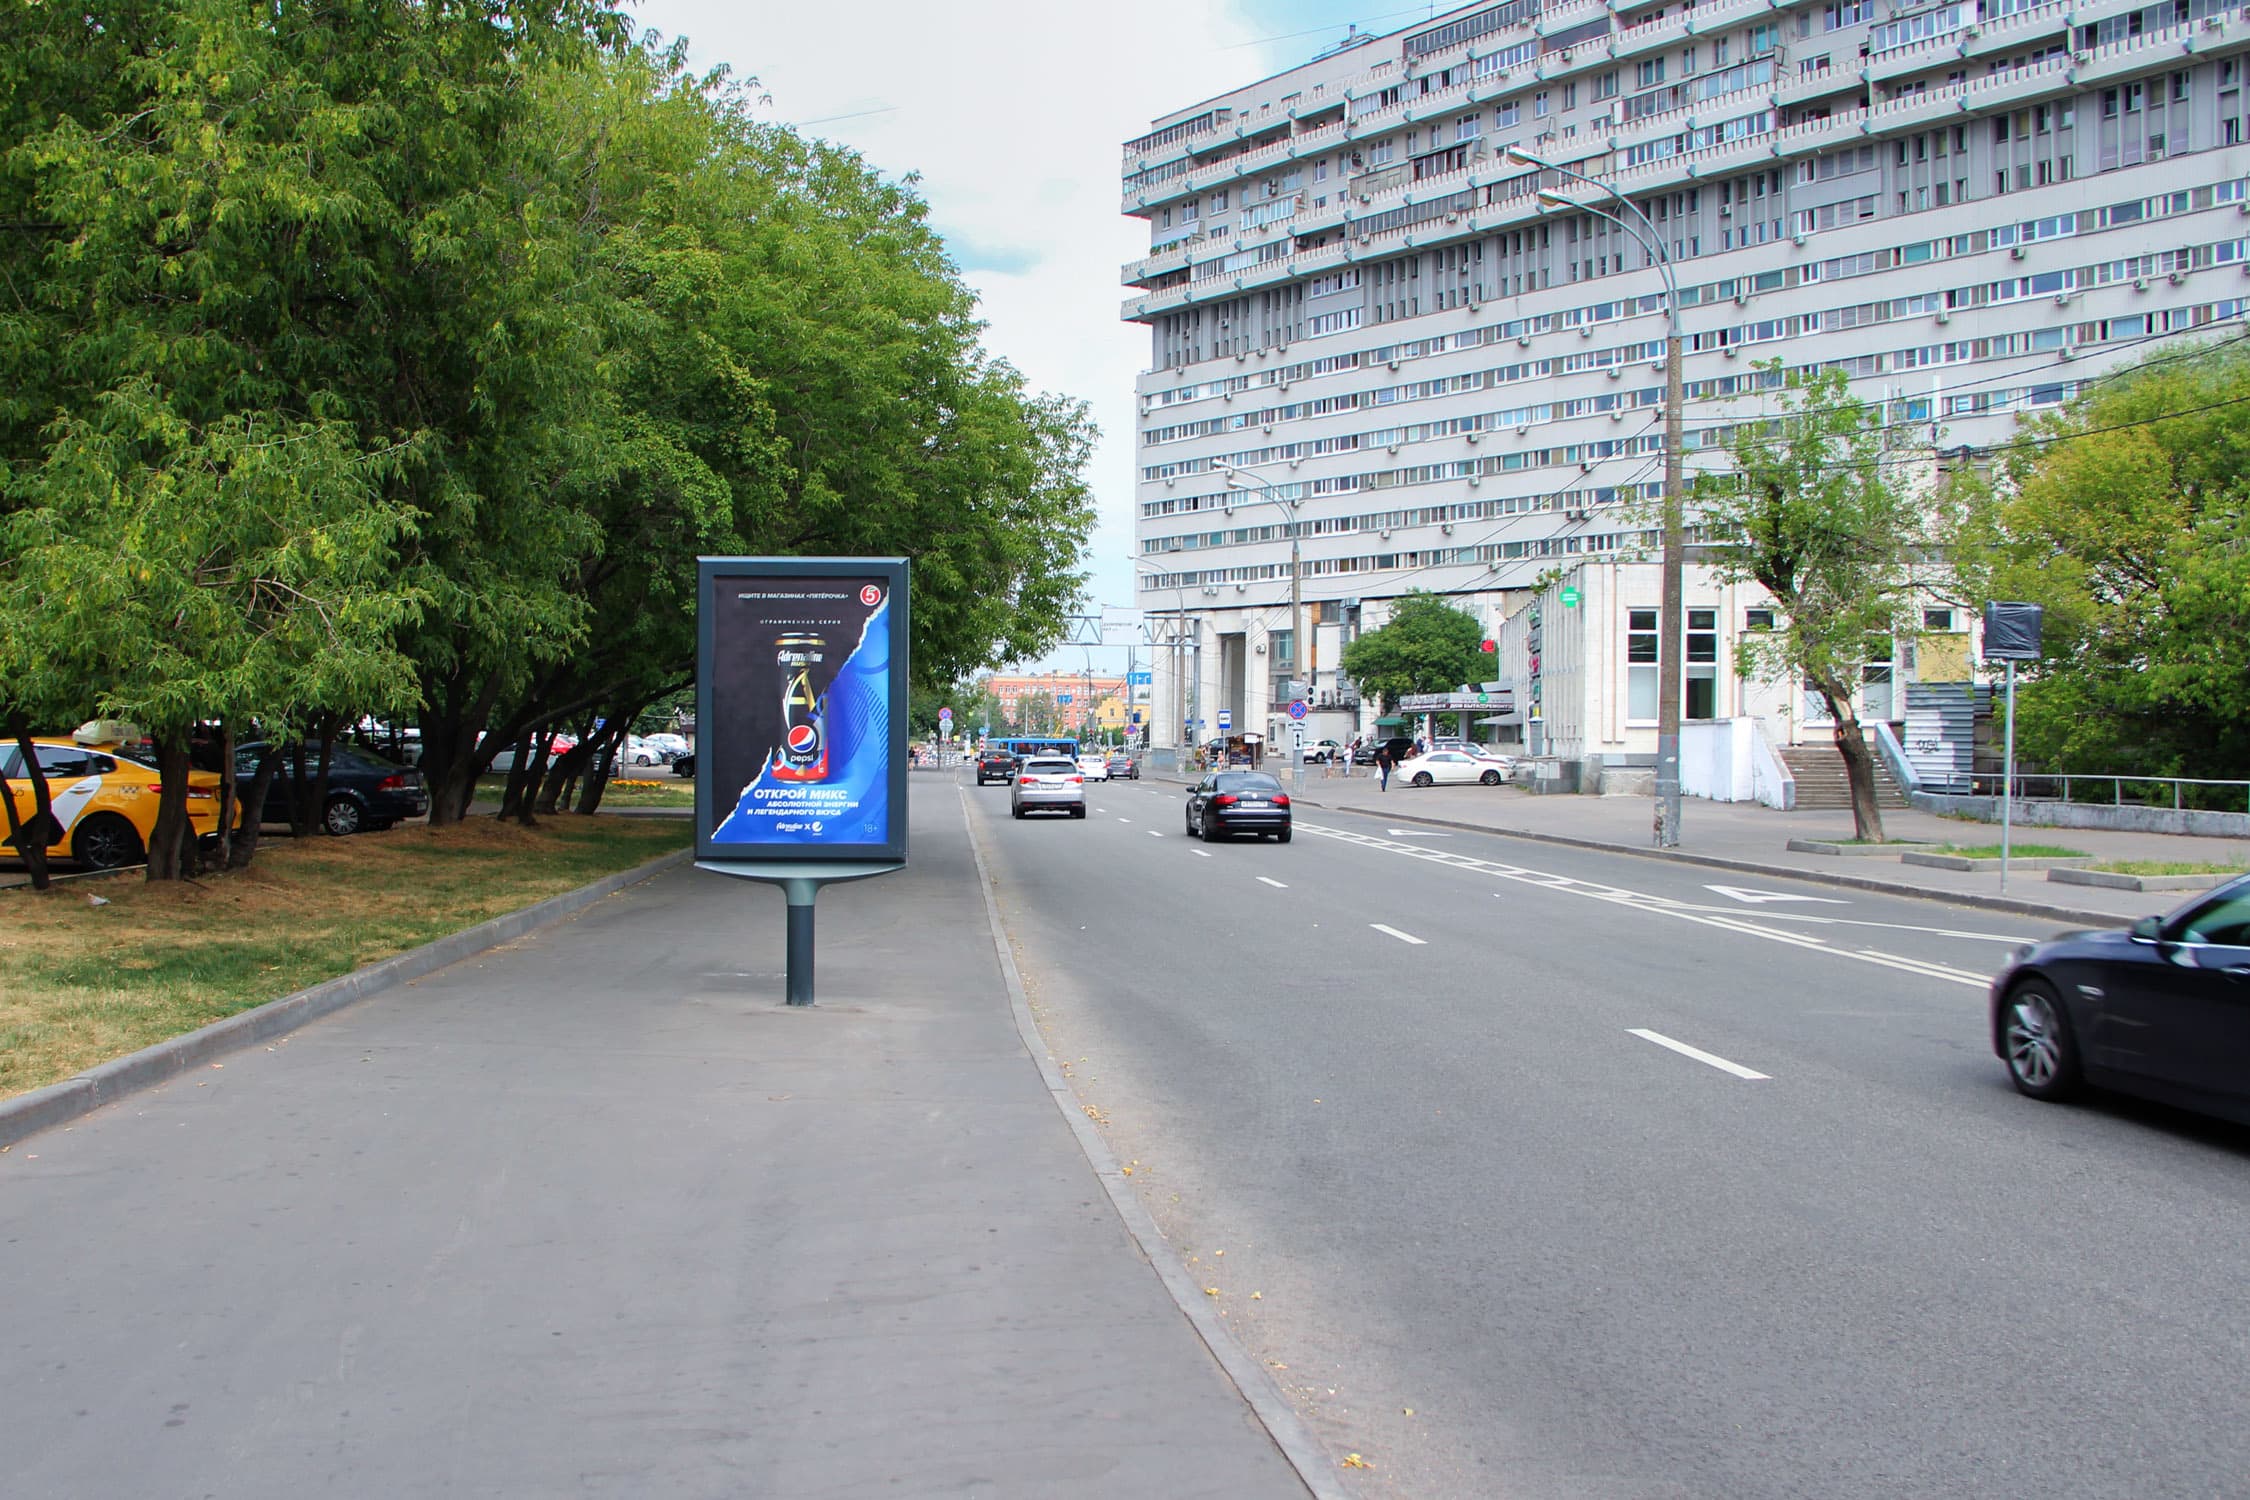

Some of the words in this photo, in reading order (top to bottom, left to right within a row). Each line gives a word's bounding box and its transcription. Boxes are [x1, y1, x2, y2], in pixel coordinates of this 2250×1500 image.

[790, 754, 814, 763] pepsi
[754, 788, 807, 800] ОТКРОЙ
[809, 789, 848, 800] МИКС
[766, 800, 822, 808] АБСОЛЮТНОЙ
[753, 808, 815, 816] ЛЕГЕНДАРНОГО
[815, 808, 842, 816] ВКУСА
